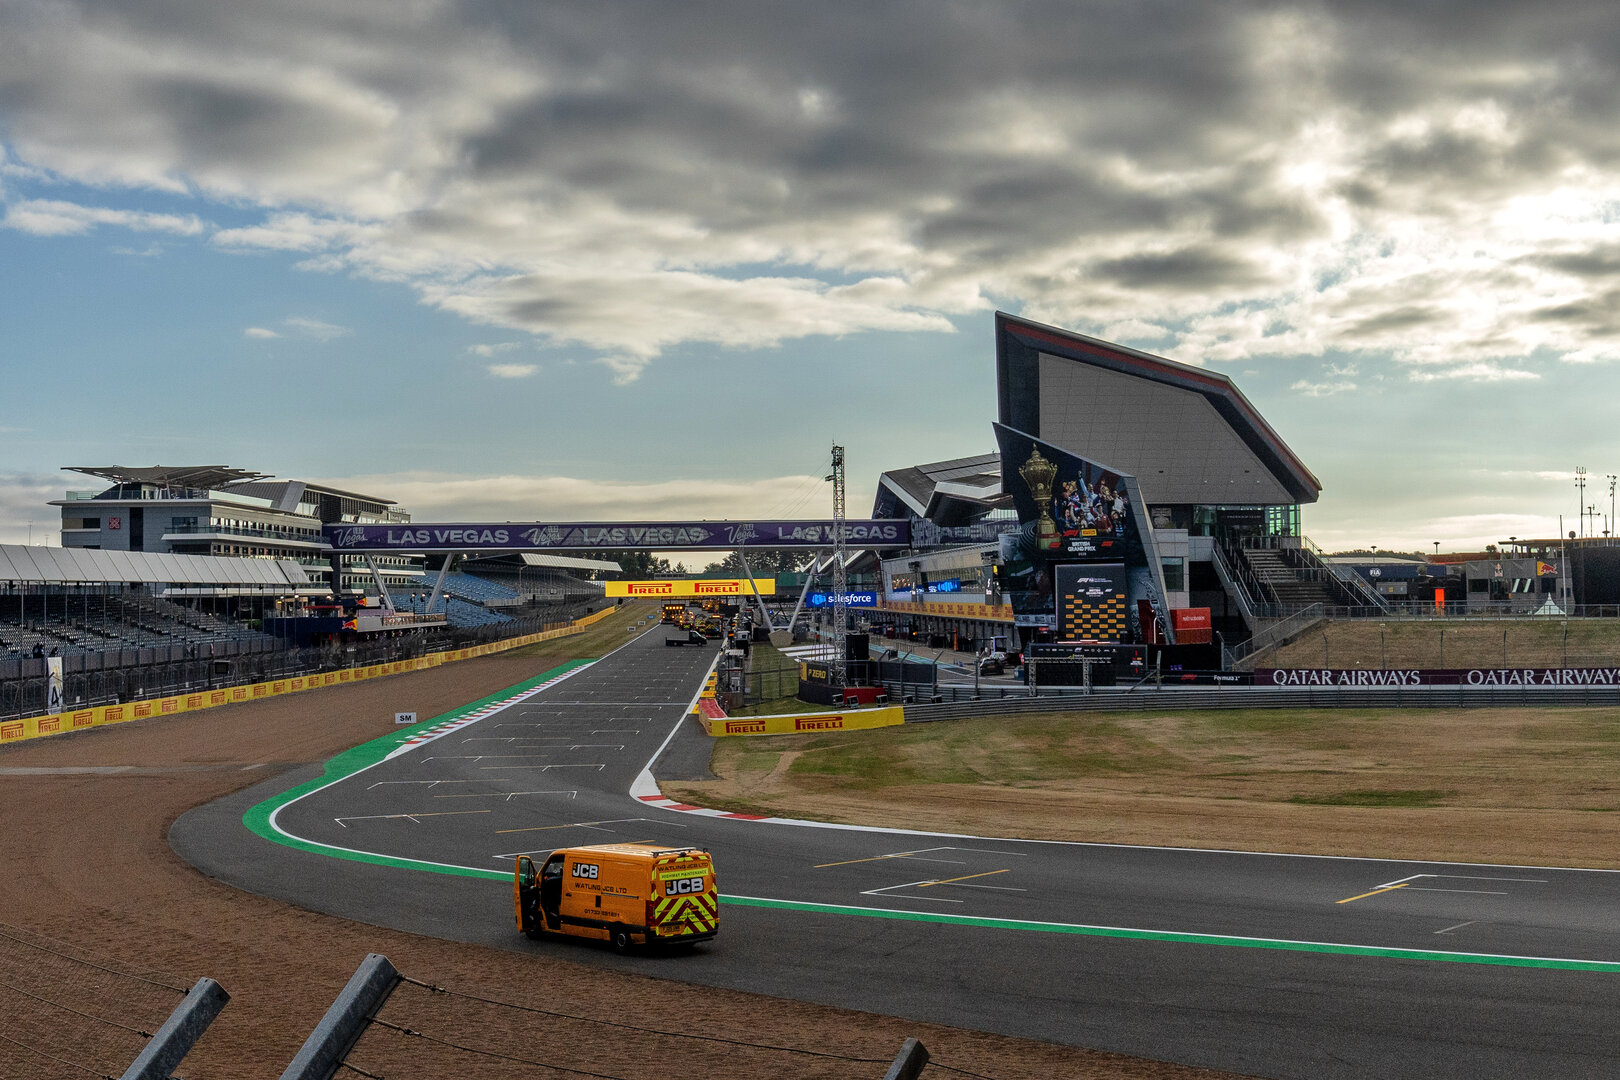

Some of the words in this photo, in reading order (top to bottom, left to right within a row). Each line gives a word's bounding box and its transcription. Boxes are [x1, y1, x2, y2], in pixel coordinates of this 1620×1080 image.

[334, 528, 369, 547] Vegas
[387, 530, 430, 543] LAS
[432, 529, 509, 543] VEGAS
[583, 528, 626, 542] LAS
[629, 528, 704, 542] VEGAS
[778, 527, 820, 540] LAS
[824, 525, 897, 540] VEGAS
[628, 583, 672, 594] PIRELLI
[695, 582, 739, 593] PIRELLI
[828, 593, 871, 604] salesforce
[812, 670, 827, 679] ZERO
[1273, 669, 1333, 685] QATAR
[1337, 670, 1421, 685] AIRWAYS
[1541, 669, 1620, 684] AIRWAY
[134, 703, 152, 717] PIRELLI
[161, 700, 178, 713] PIRELLI
[73, 711, 93, 727] PIRELLI
[105, 707, 123, 721] PIRELLI
[38, 717, 60, 734] PIRELLI
[726, 720, 765, 733] PIRELLI
[795, 716, 843, 730] PIRELLI
[1, 723, 24, 740] PIRELLI
[572, 863, 599, 879] JCB
[575, 882, 601, 890] WATLING
[666, 877, 704, 895] JCB
